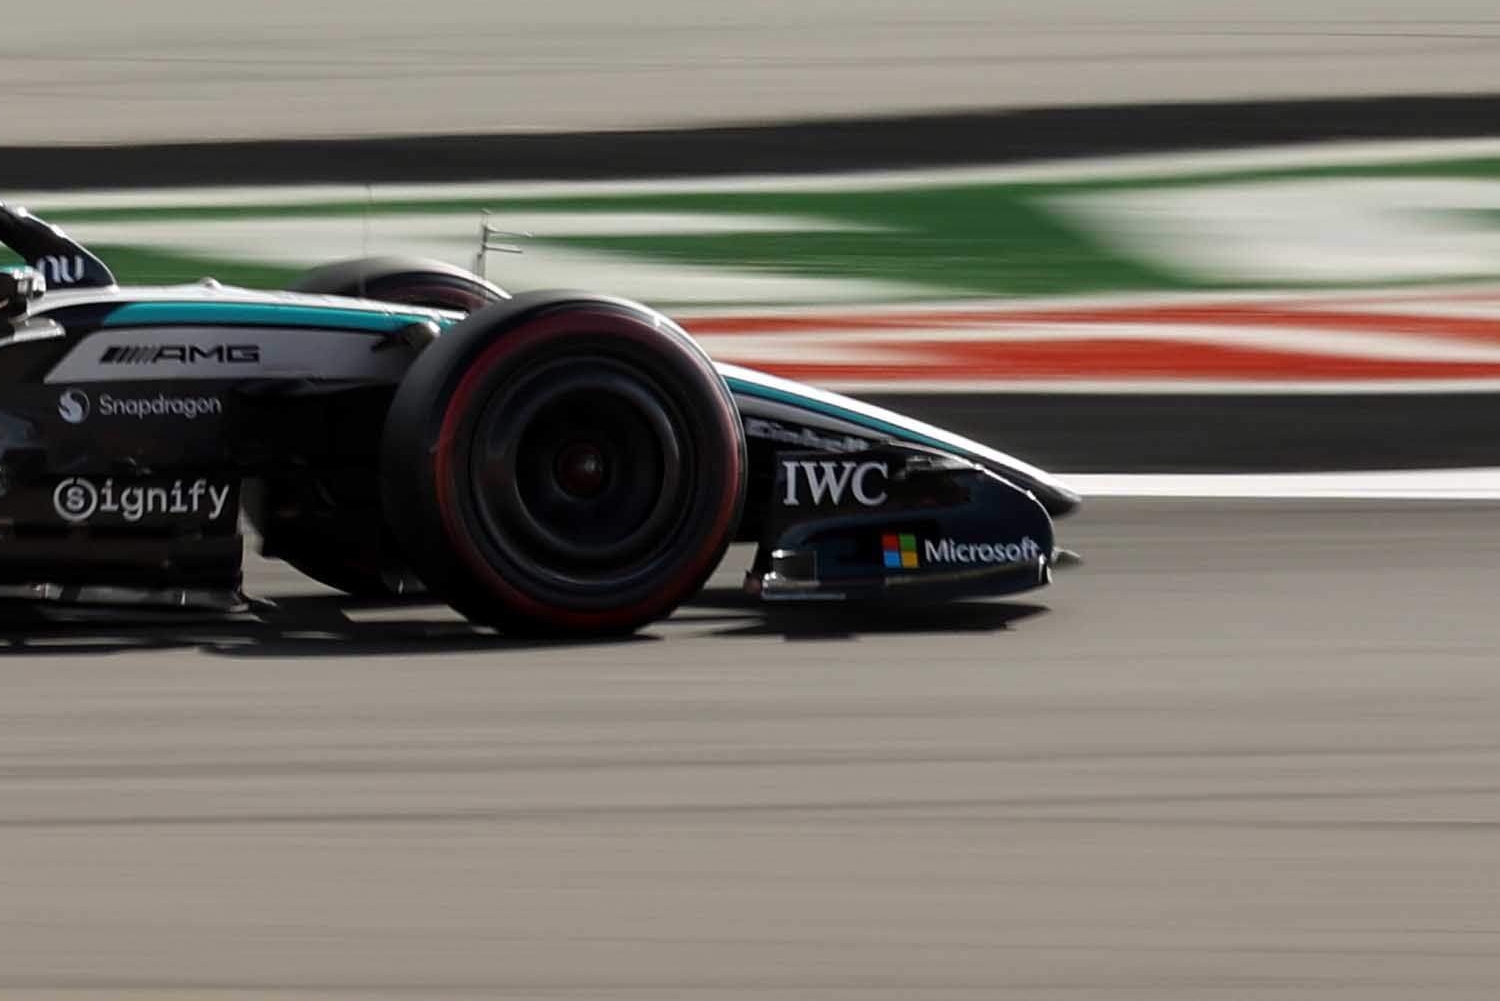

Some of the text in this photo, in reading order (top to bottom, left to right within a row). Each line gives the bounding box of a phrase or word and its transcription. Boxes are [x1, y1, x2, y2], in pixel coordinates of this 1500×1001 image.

[151, 345, 261, 365] AMG
[99, 393, 223, 419] Snapdragon
[782, 460, 889, 507] IWC
[923, 535, 1041, 564] Microsoft
